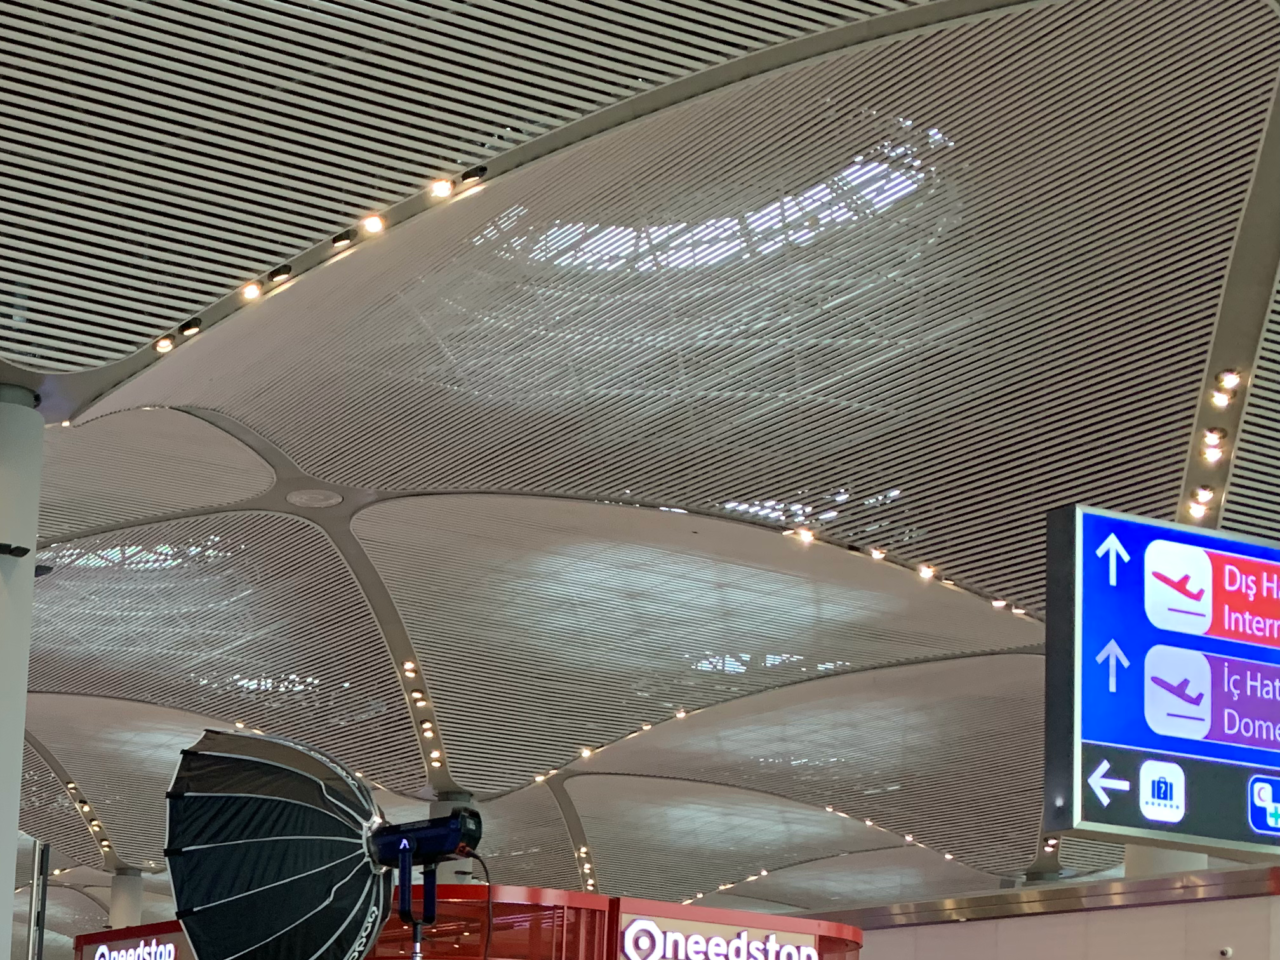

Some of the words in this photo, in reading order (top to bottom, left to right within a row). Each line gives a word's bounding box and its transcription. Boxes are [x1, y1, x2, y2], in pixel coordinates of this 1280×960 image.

[1223, 564, 1257, 602] Dış
[1261, 571, 1280, 599] H
[1223, 661, 1241, 701] İç
